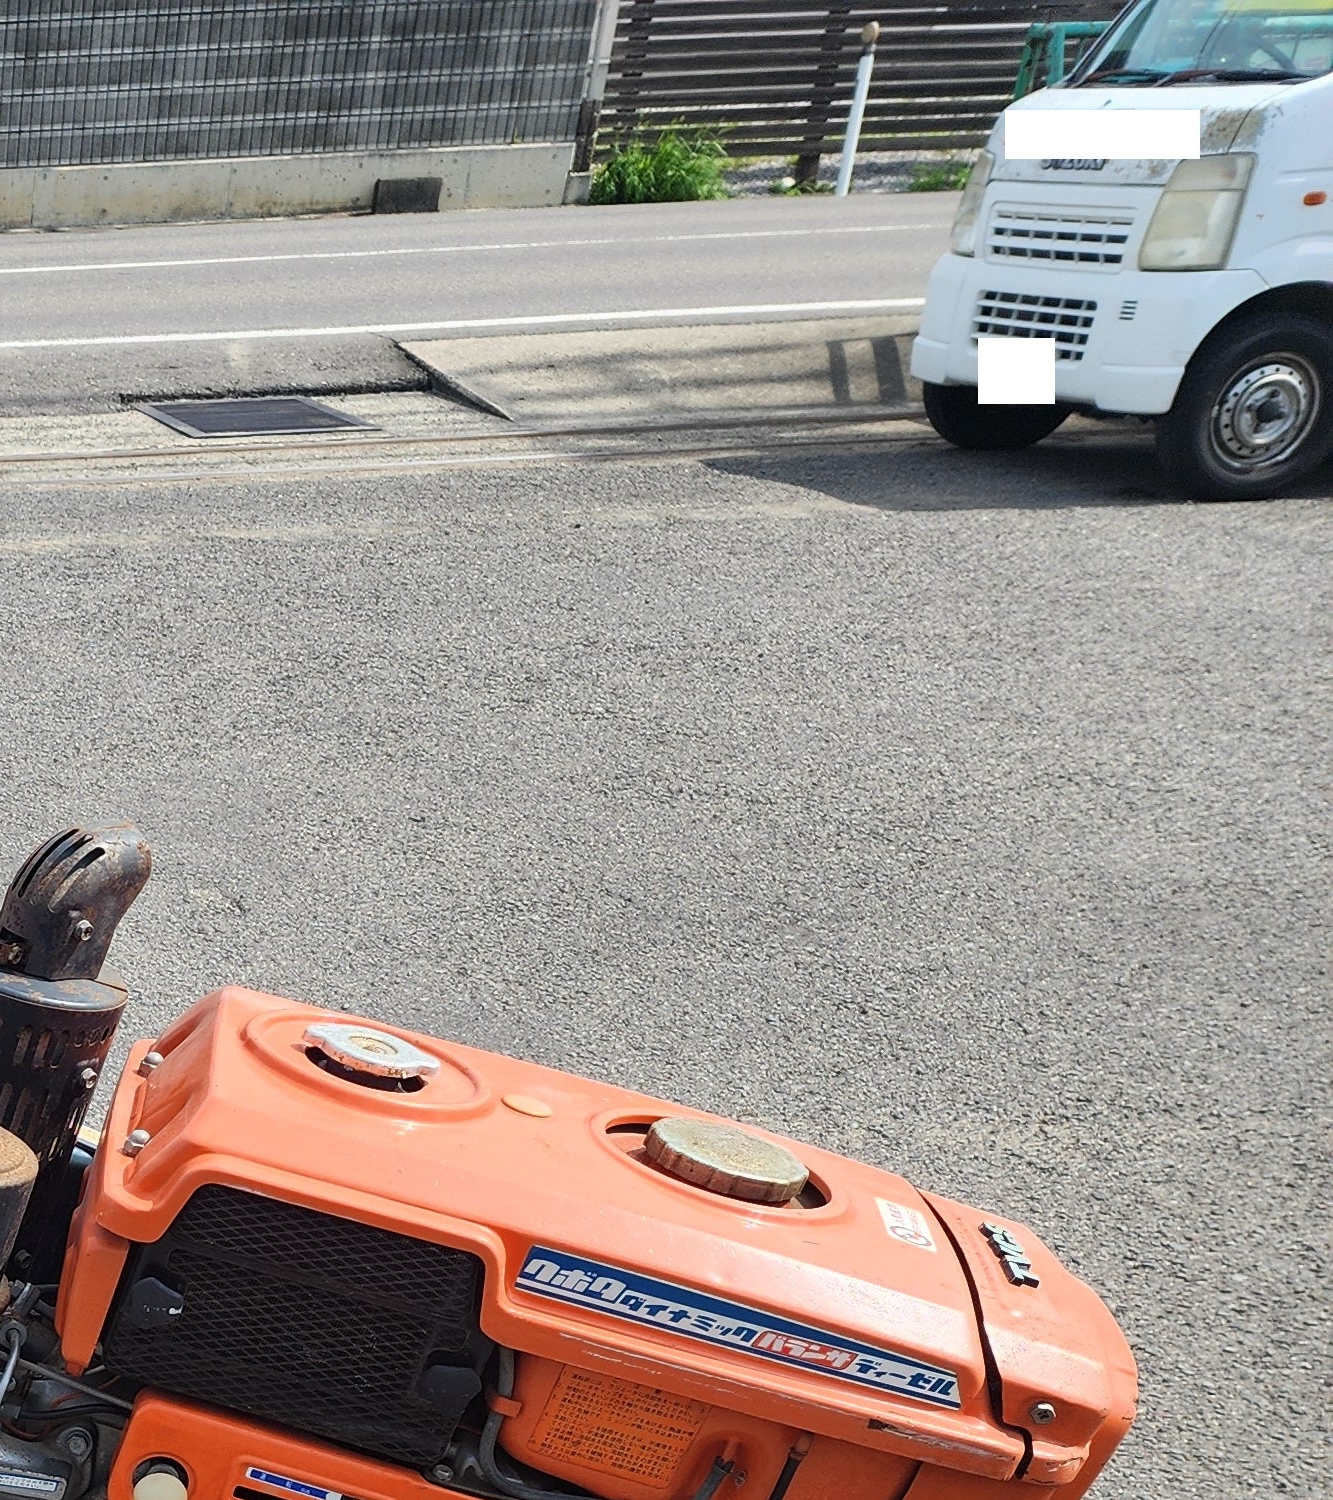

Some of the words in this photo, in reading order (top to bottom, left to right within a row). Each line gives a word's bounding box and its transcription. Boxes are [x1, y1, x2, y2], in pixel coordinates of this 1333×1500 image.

[523, 1257, 627, 1304] クボタ
[619, 1292, 760, 1344] ダイナミック
[757, 1332, 851, 1369] バランサ
[854, 1356, 958, 1397] ディーゼル
